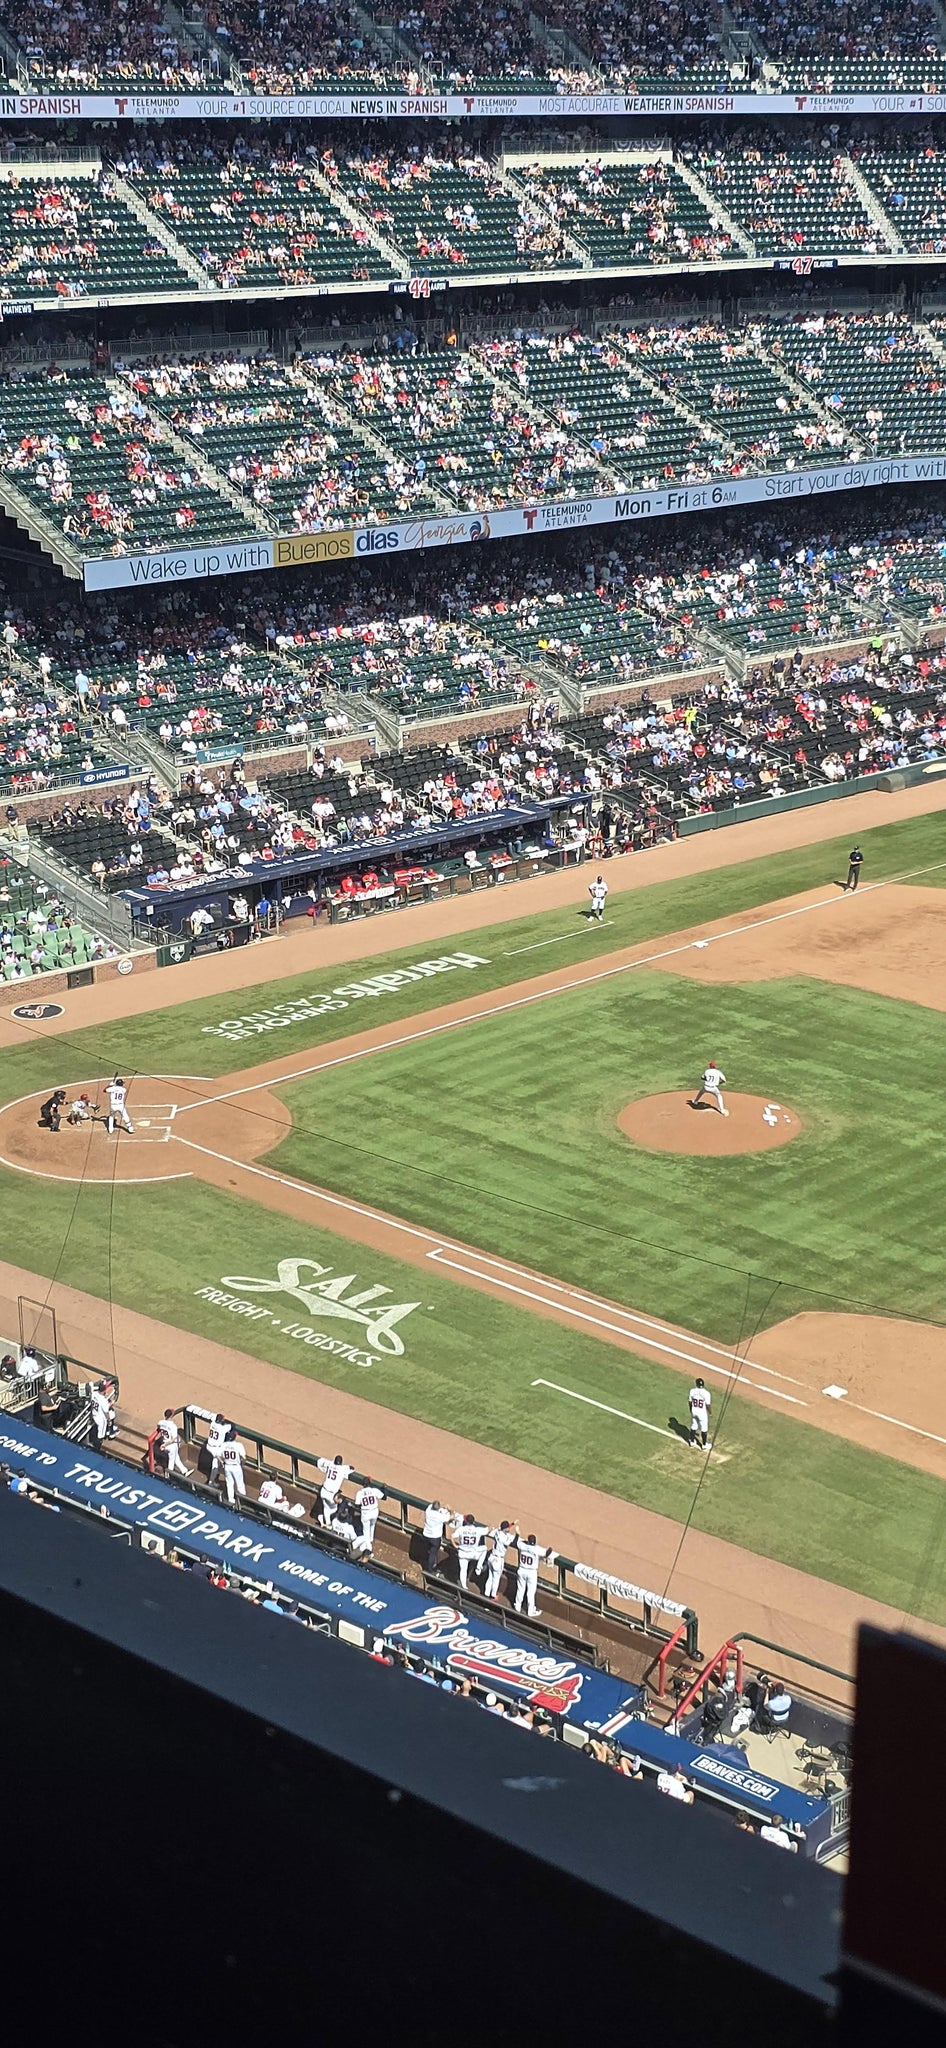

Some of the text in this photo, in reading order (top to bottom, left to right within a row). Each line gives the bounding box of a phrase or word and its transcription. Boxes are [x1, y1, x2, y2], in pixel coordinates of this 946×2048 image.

[2, 98, 81, 114] IN SPANISH
[132, 98, 180, 107] TELEMUNDO
[196, 100, 448, 115] YOUR #1 SOURCE OF LOCAL NEWS IN SPANISH
[477, 98, 517, 107] TELEMUNDO
[539, 97, 734, 112] MOST ACCURATE WEATHER IN SPANISH
[810, 97, 854, 105] TELEMUNDO
[872, 97, 904, 111] YOUR
[909, 97, 923, 110] #1
[135, 107, 176, 115] ATLANTA
[792, 256, 813, 275] 47
[409, 277, 431, 299] 44
[2, 304, 32, 314] MATHEWS
[765, 478, 803, 497] Start
[807, 474, 842, 494] your
[843, 468, 869, 490] day
[871, 464, 908, 485] right
[541, 503, 593, 518] TELEMUNDO
[615, 497, 650, 518] Mon
[667, 492, 689, 511] Fri
[692, 491, 708, 507] at
[545, 514, 588, 529] ATLANTA
[128, 519, 468, 582] Wake up with Buenos días Georgia
[95, 769, 127, 781] HYUNDAI
[201, 993, 333, 1034] CASINOS
[217, 999, 350, 1042] CHEROKEE
[114, 1093, 123, 1101] 18
[220, 1257, 422, 1356] SAIA
[193, 1286, 274, 1321] FREIGHT
[280, 1322, 382, 1368] LOGISTICS
[692, 1398, 704, 1409] 86
[223, 1450, 237, 1461] 80
[327, 1469, 338, 1481] 15
[362, 1495, 376, 1507] 88
[463, 1535, 477, 1546] 53
[35, 1452, 58, 1465] TO
[64, 1463, 164, 1510] TRUIST
[191, 1520, 275, 1563] PARK
[278, 1559, 330, 1587] HOME
[327, 1580, 355, 1596] OF
[351, 1590, 388, 1613] THE
[383, 1605, 577, 1678] Braves
[696, 1755, 774, 1797] BRAVES.COM
